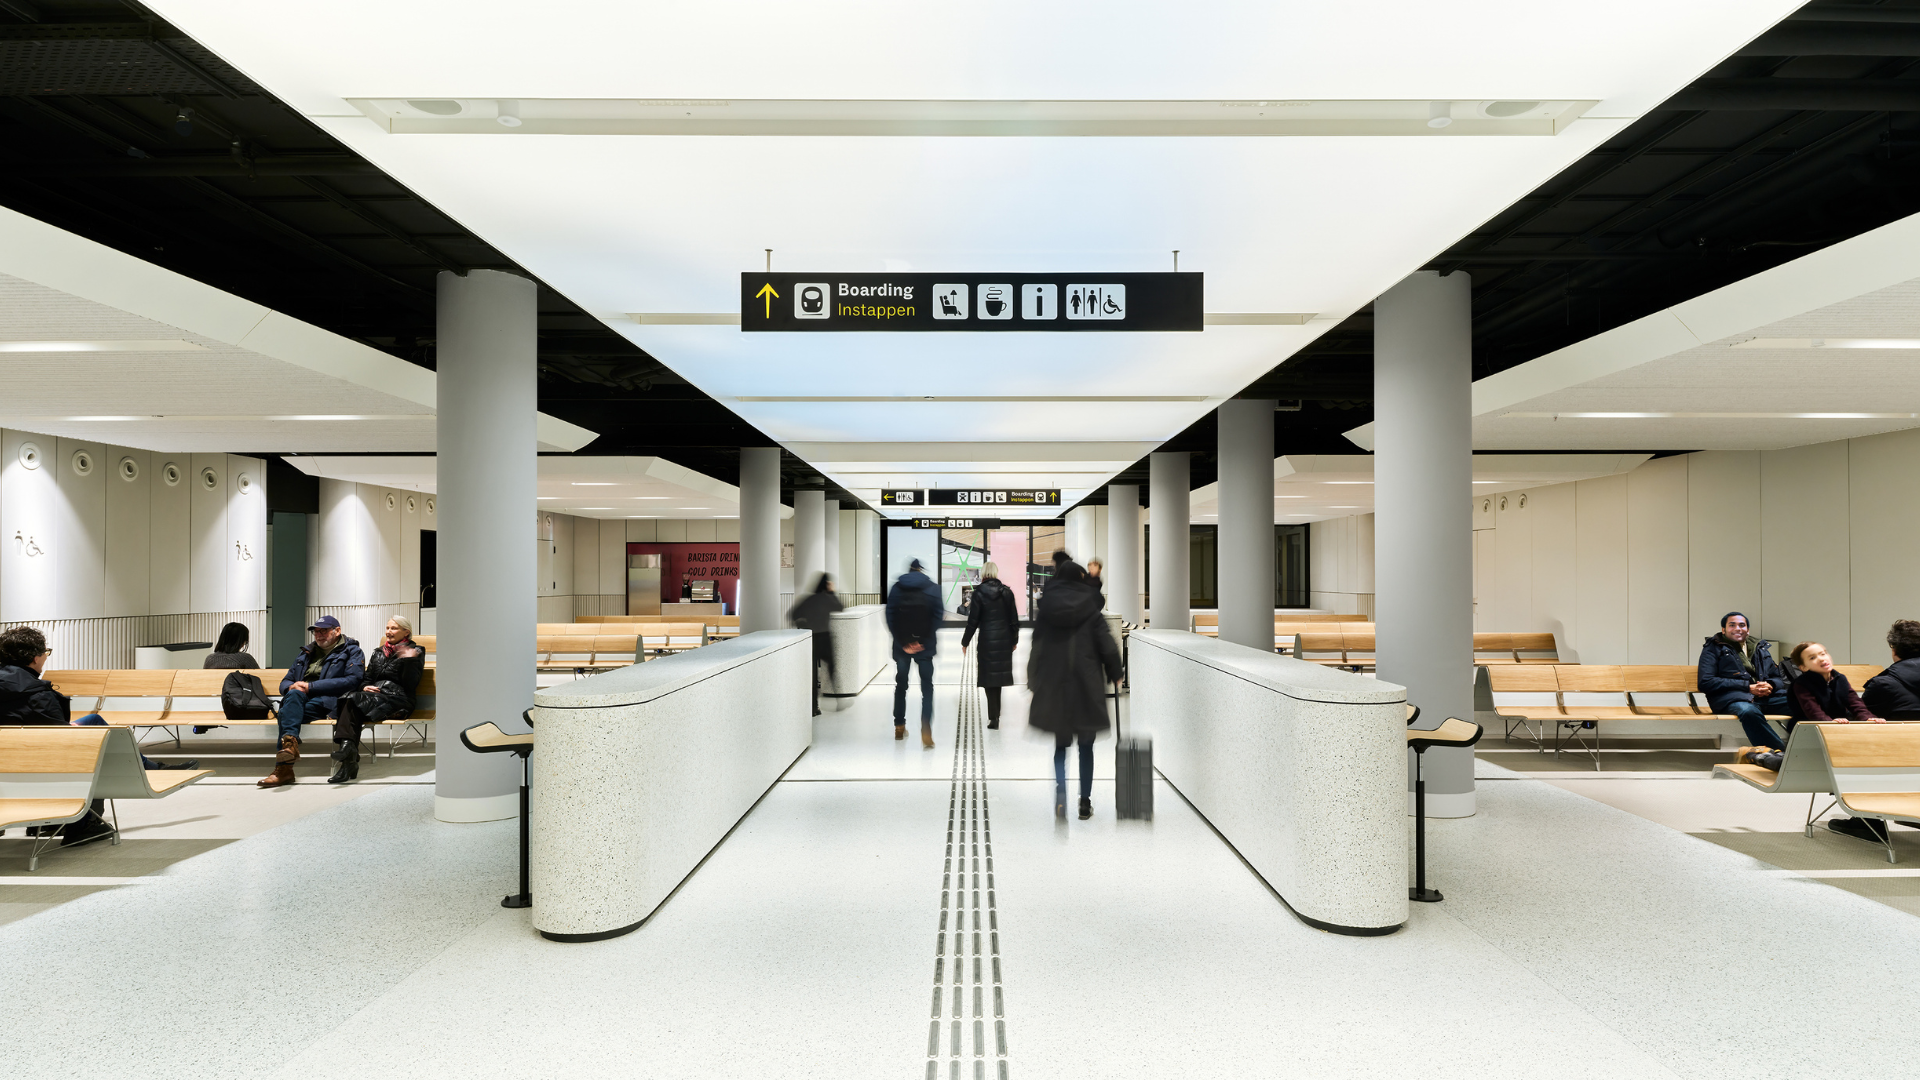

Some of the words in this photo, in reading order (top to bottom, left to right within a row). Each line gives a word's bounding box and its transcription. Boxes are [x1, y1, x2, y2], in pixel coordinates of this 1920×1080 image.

[838, 283, 914, 300] Boarding
[838, 303, 915, 319] Instappen
[687, 552, 717, 562] BARISTA
[719, 552, 740, 562] DRIN
[687, 566, 707, 576] COLD
[710, 566, 738, 576] DRINKS
